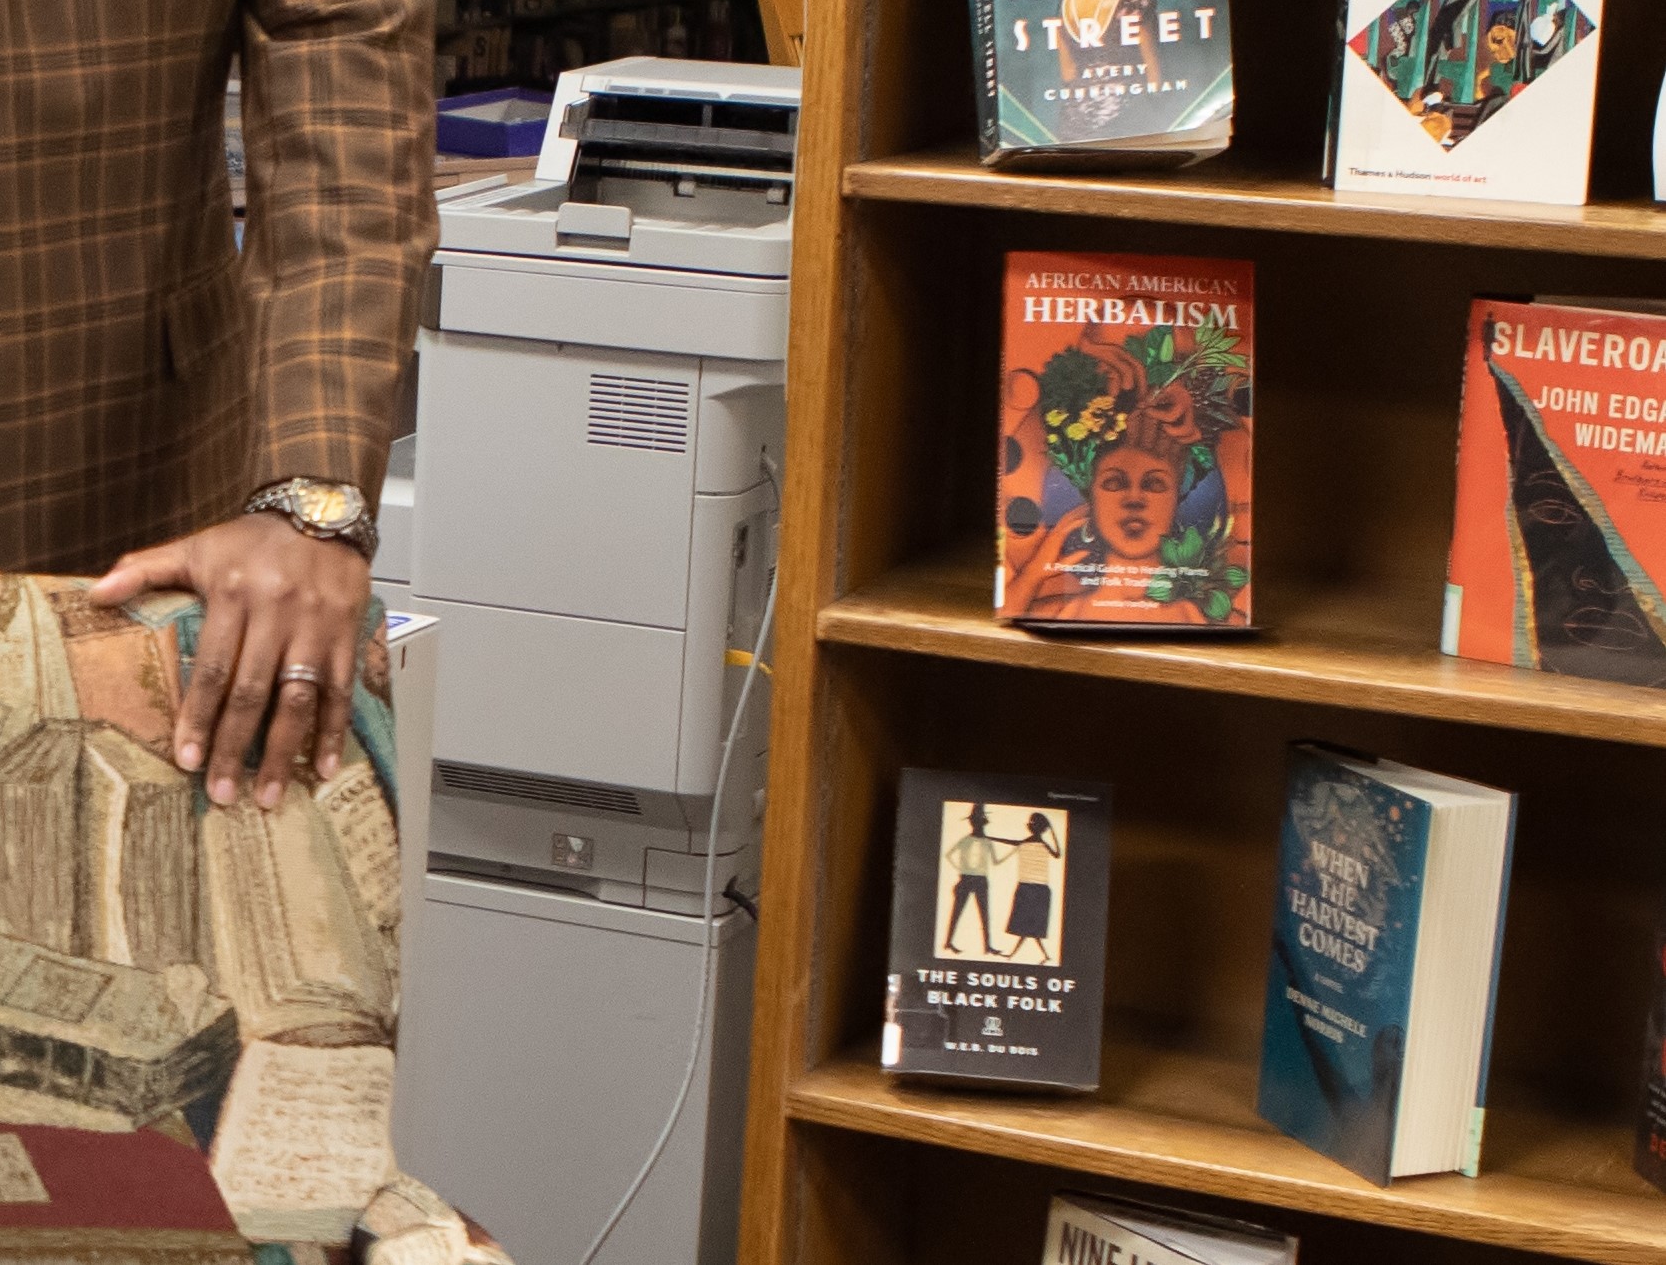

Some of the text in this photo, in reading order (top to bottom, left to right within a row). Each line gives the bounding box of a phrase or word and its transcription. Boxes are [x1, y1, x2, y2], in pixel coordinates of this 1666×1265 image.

[1012, 7, 1217, 52] STREET
[1081, 64, 1149, 80] AVERY
[1043, 79, 1189, 102] CUNNINGHAM
[1024, 272, 1238, 297] AFRICAN AMERICAN
[1023, 296, 1239, 330] HERBALISM
[1310, 839, 1371, 890] WHEN
[1319, 872, 1356, 915] THE
[1289, 887, 1380, 956] HARVEST
[1298, 922, 1368, 975] COMES
[917, 969, 1077, 993] THE SOULS OF
[926, 989, 1063, 1014] BLACK FOLK
